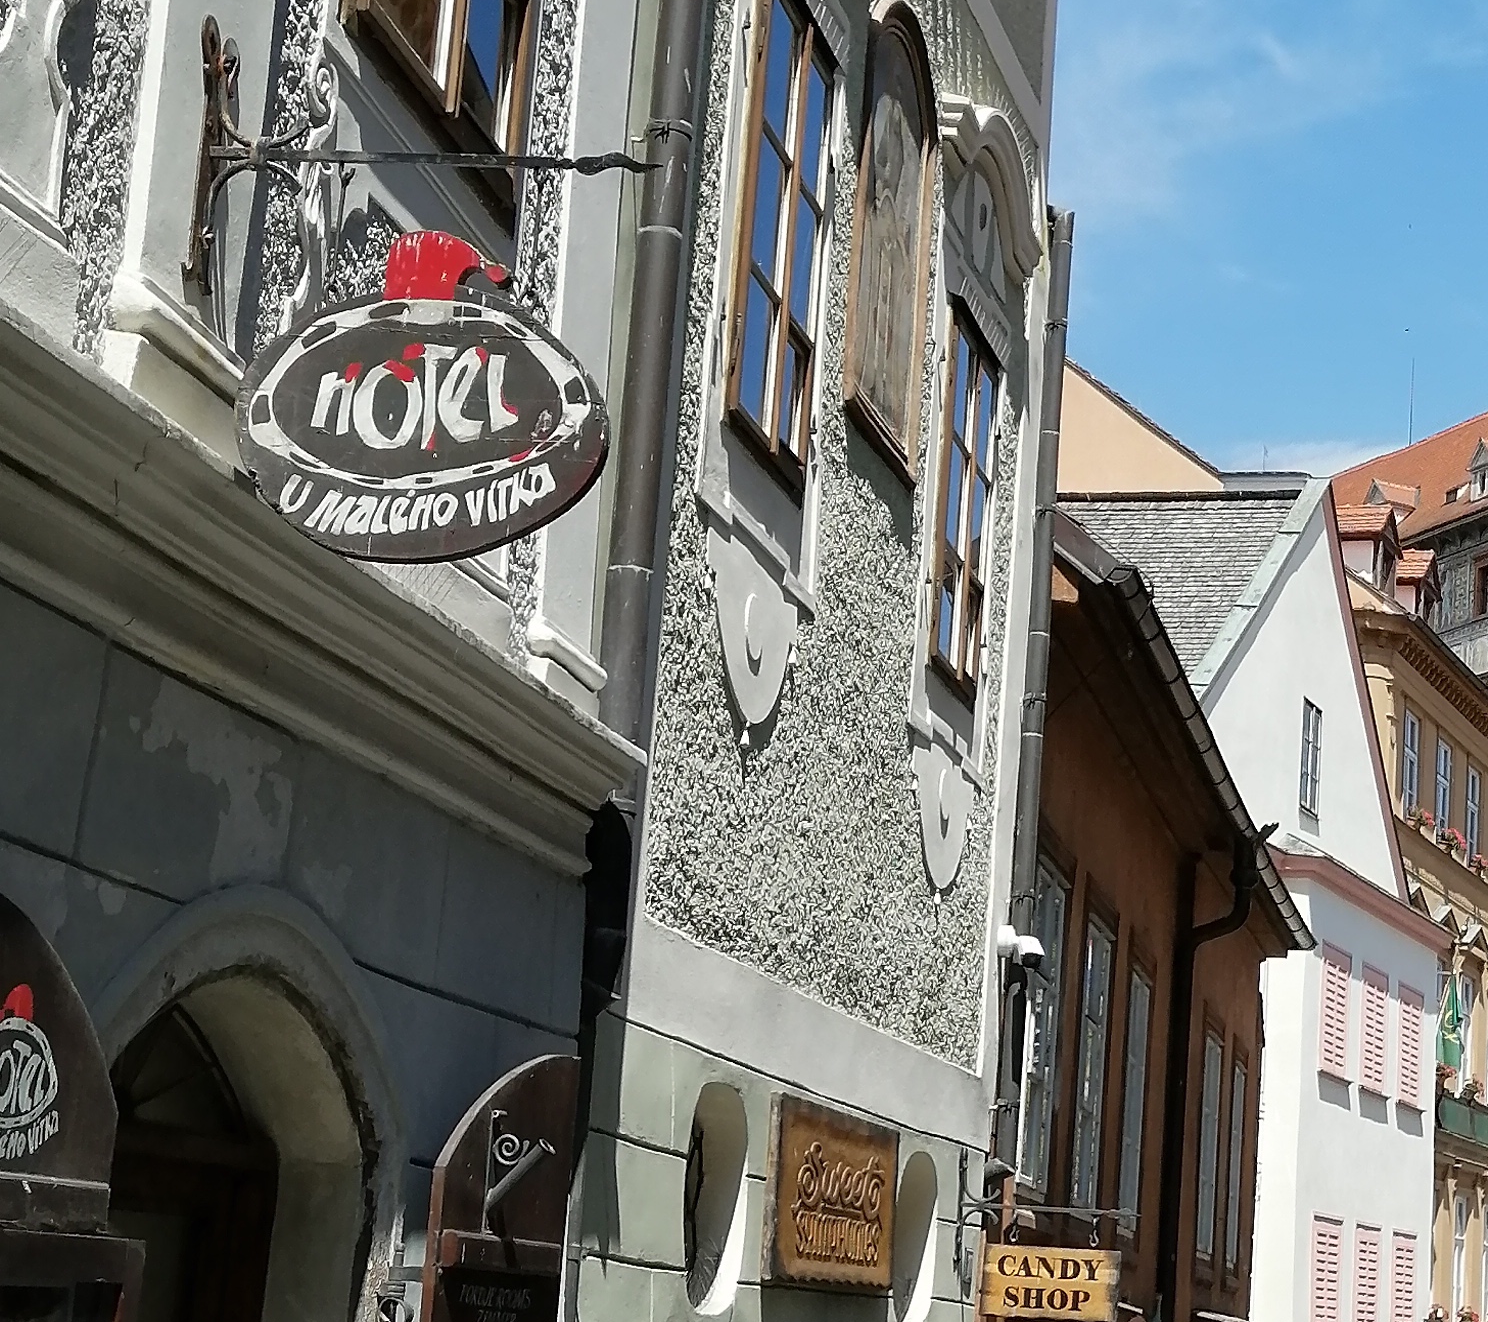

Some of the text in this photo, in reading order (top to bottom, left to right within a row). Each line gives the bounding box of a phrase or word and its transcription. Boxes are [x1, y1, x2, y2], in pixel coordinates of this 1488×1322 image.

[279, 473, 314, 515] U
[790, 1141, 885, 1220] Sweet
[997, 1254, 1104, 1281] CANDY
[1003, 1286, 1091, 1311] SHOP
